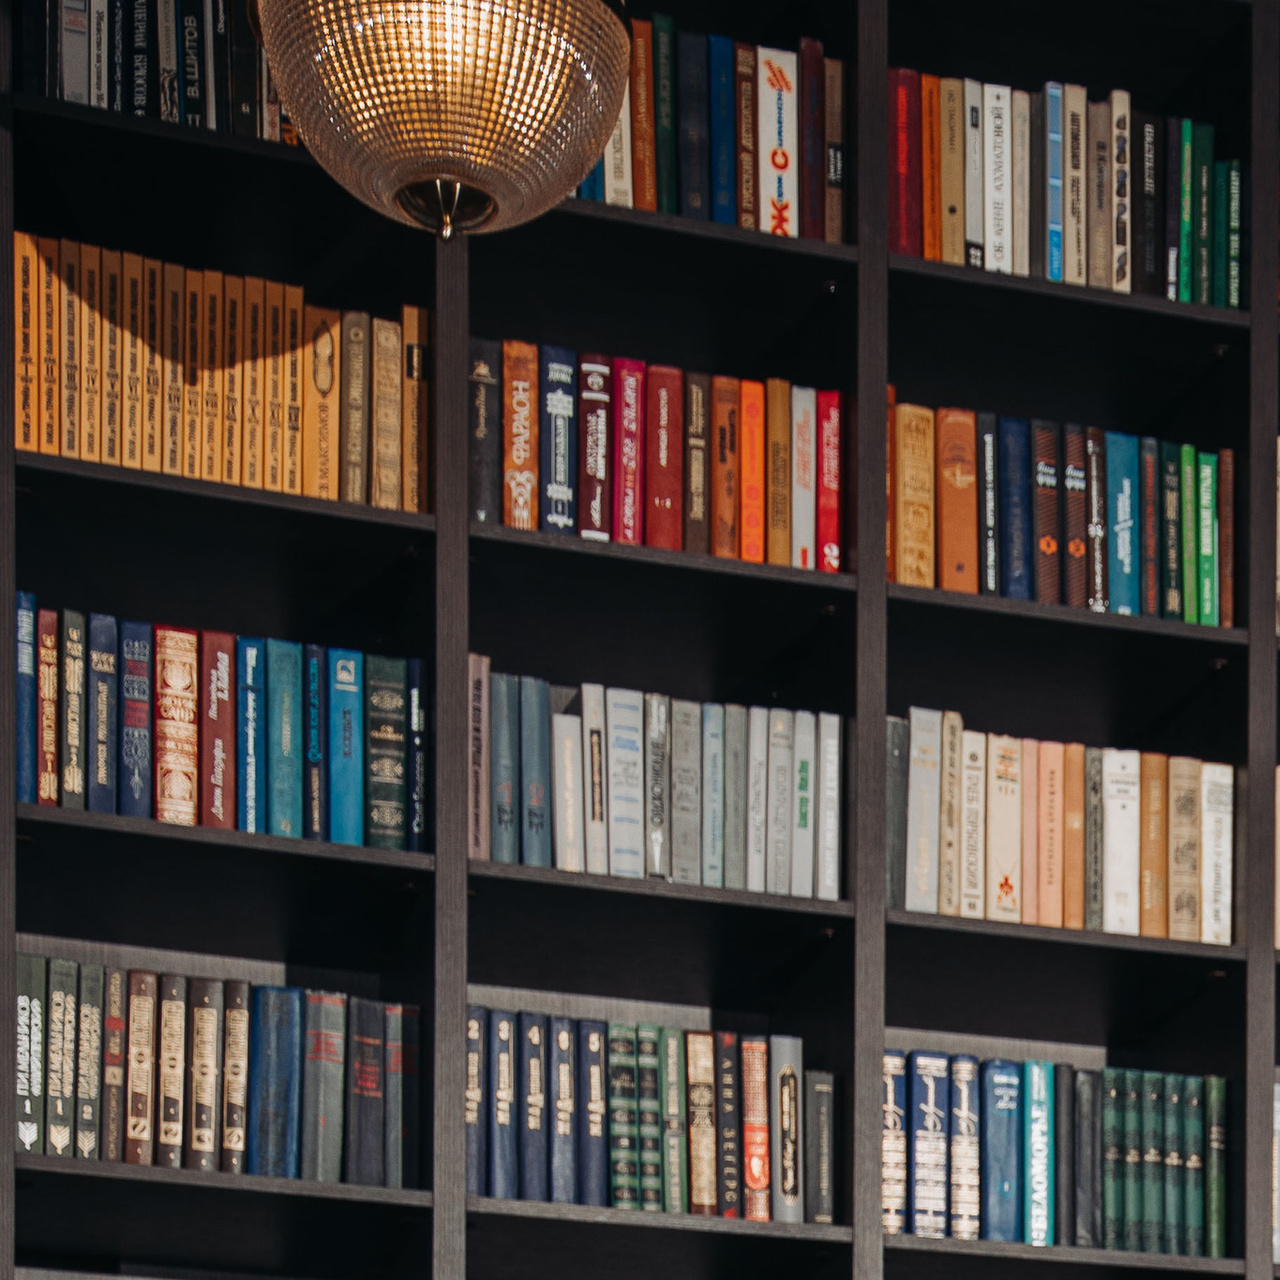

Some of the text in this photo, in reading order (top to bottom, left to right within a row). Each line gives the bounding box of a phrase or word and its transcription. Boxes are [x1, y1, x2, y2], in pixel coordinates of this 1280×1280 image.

[184, 15, 200, 99] В.ШИТОВ
[989, 106, 1005, 192] АХМАТОВОЙ
[513, 380, 530, 465] ФАРАОН
[721, 1057, 738, 1114] АННА
